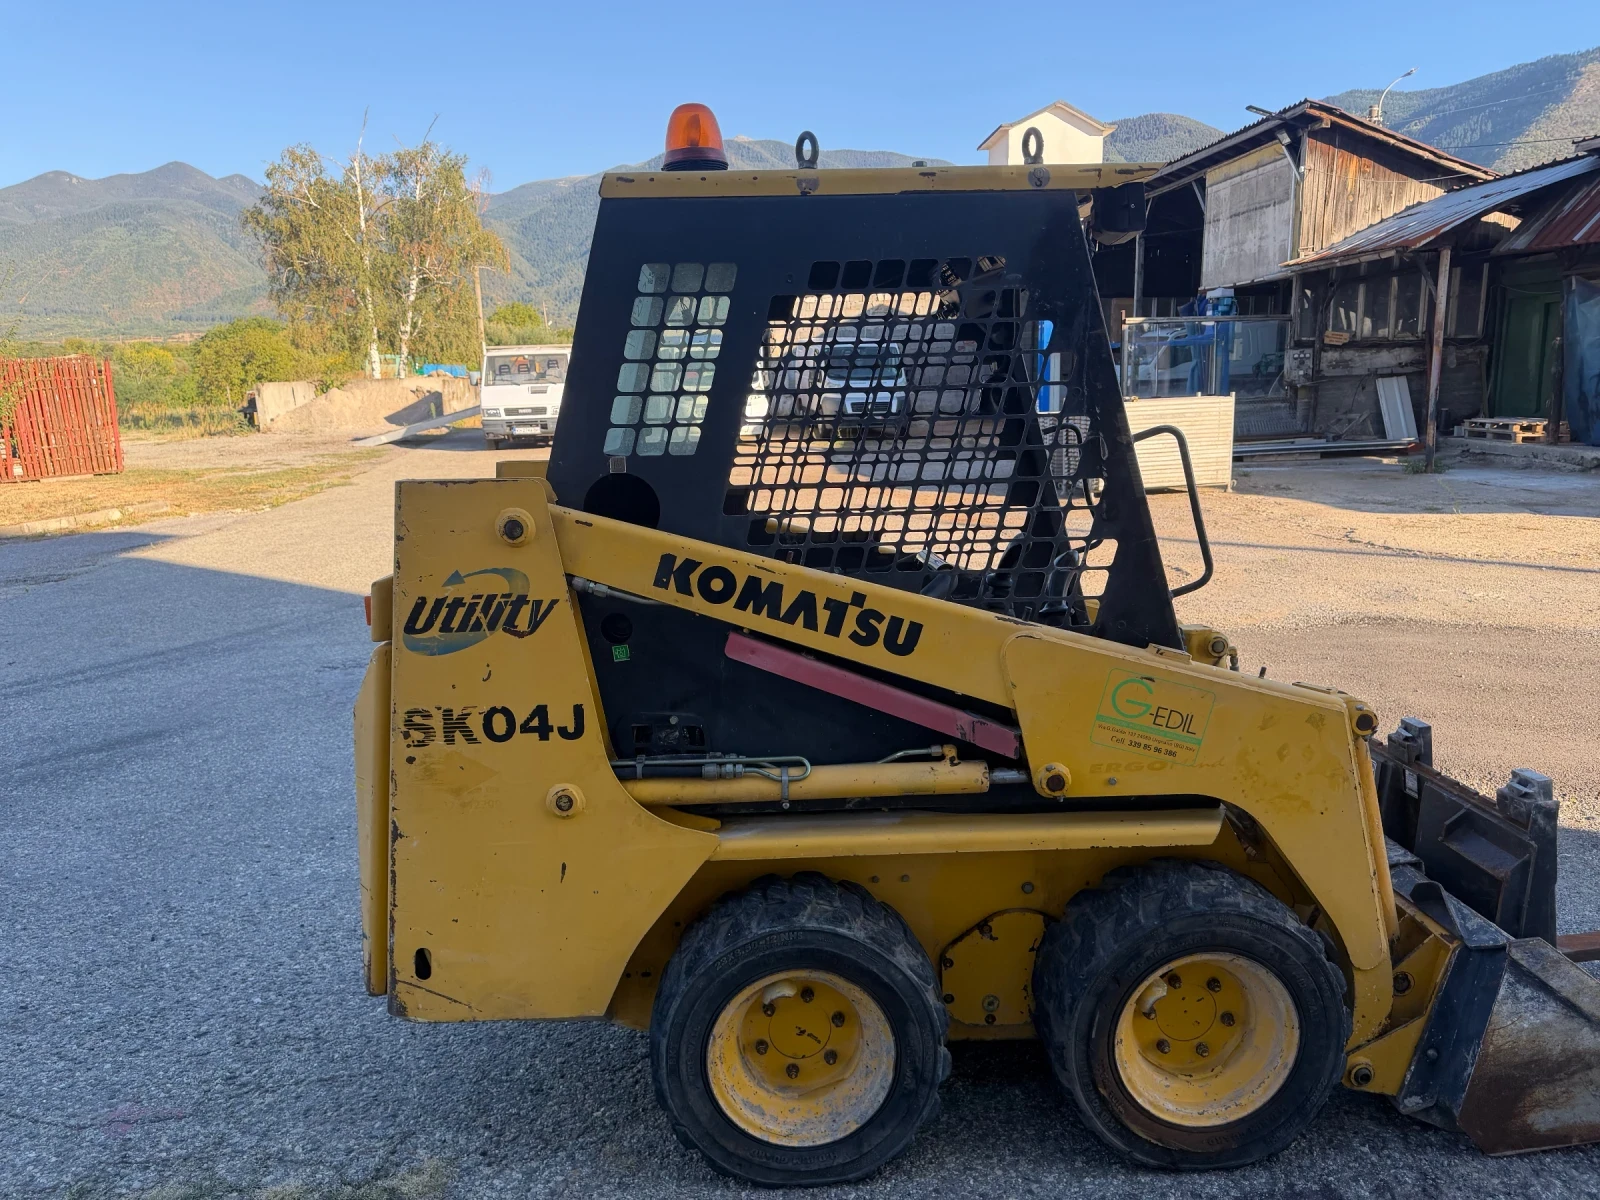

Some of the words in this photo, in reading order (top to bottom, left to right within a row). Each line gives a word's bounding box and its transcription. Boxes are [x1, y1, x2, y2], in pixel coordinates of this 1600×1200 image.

[403, 592, 560, 639] Utility
[652, 553, 924, 657] KOMATSU
[401, 703, 585, 749] SK04J
[1111, 677, 1196, 736] G-EDIL
[1128, 739, 1142, 749] 339
[1142, 743, 1152, 752] 85
[1153, 746, 1163, 754] 96
[1163, 748, 1178, 758] 386
[780, 931, 803, 941] NHS
